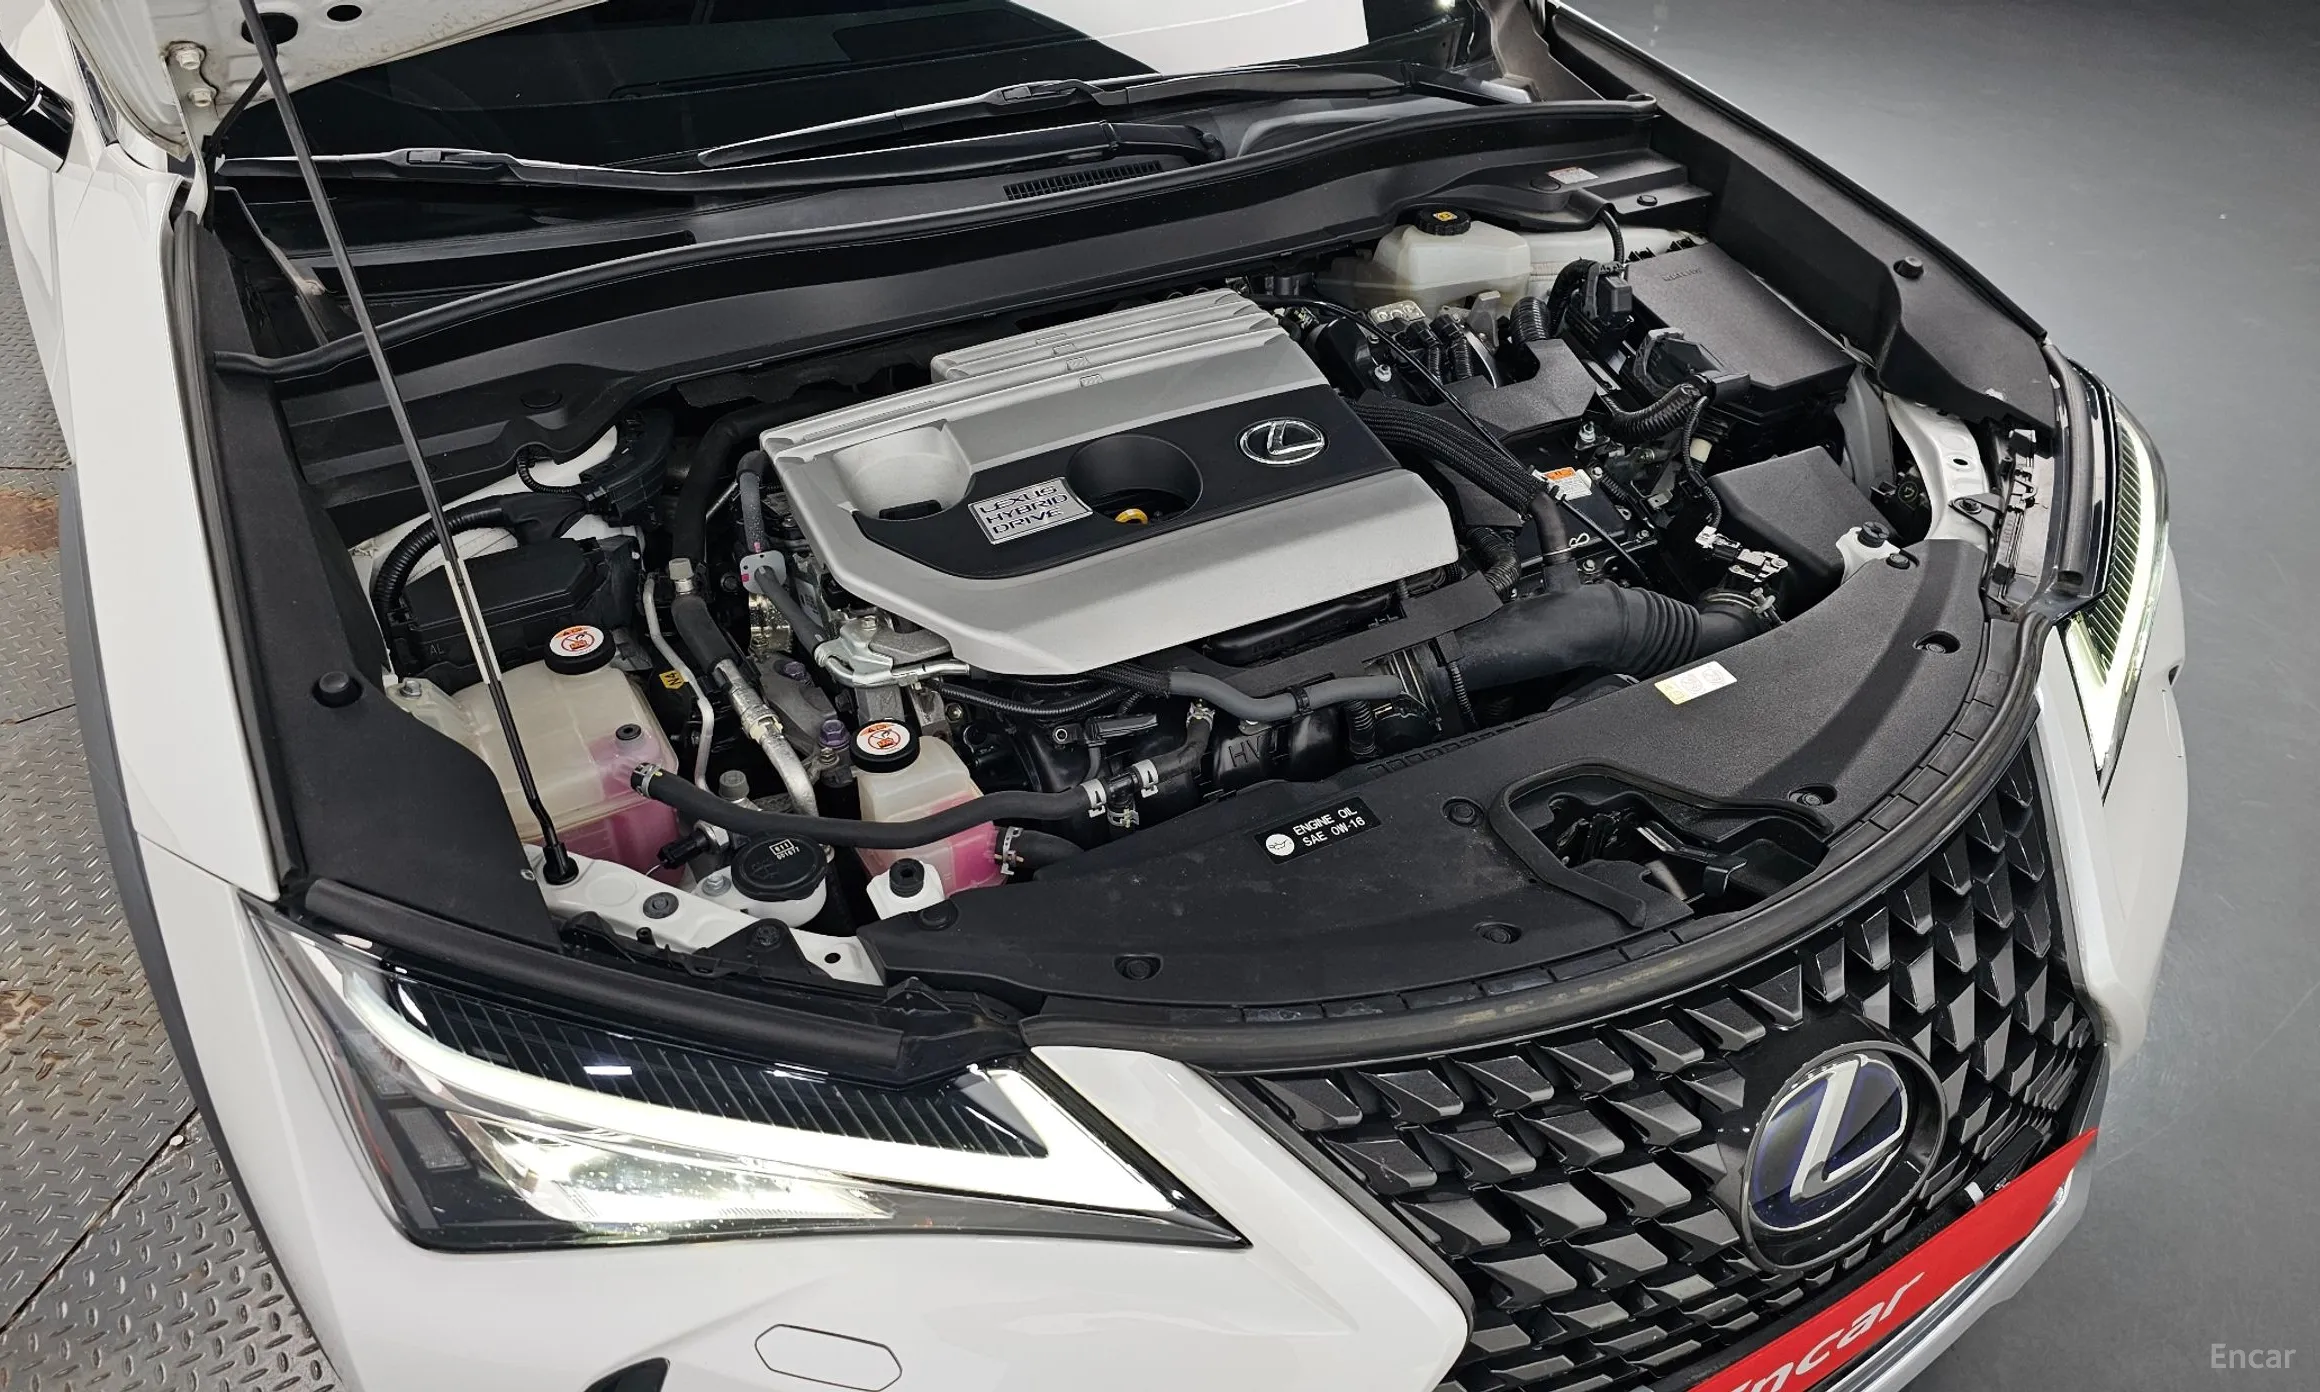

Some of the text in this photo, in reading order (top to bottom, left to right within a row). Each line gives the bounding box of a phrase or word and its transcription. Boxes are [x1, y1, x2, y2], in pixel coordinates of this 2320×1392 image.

[980, 485, 1057, 513] LEXUS
[986, 494, 1068, 524] HYBRID
[992, 507, 1064, 534] DRIVE
[1228, 735, 1261, 768] HV
[1293, 806, 1358, 836] ENGINE OIL
[1302, 816, 1366, 847] SAE 0W-16
[1731, 1271, 1926, 1392] ncar
